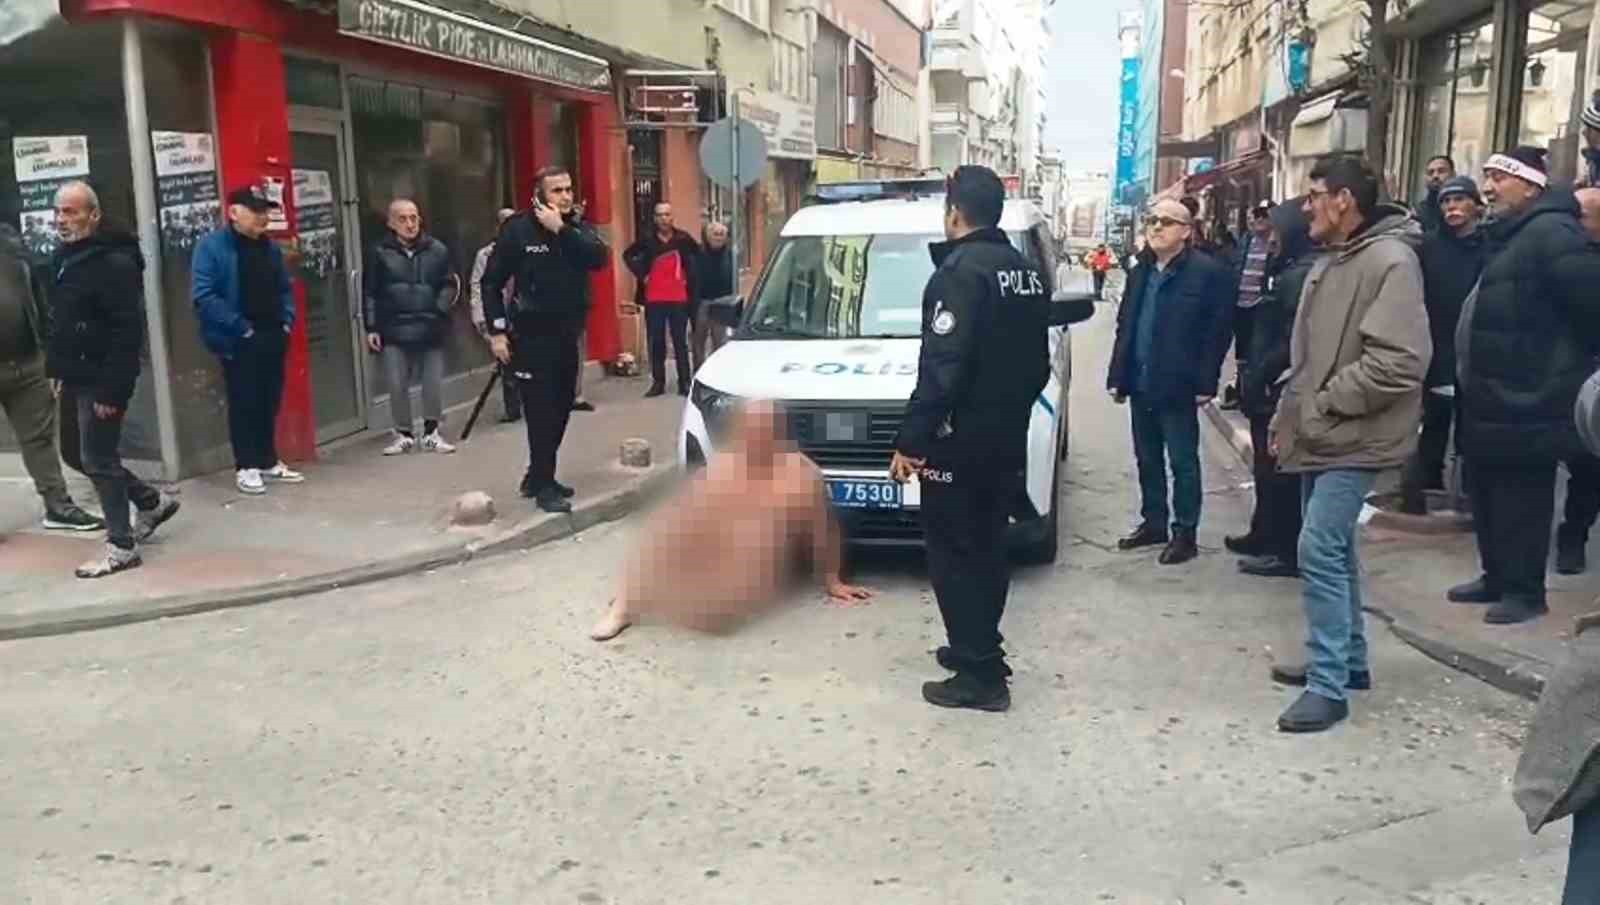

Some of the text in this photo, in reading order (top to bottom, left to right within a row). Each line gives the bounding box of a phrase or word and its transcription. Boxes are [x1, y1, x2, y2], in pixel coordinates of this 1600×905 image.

[437, 20, 475, 59] PİDE
[997, 269, 1043, 297] POLİS
[780, 360, 918, 375] POLİS
[843, 483, 894, 502] 7530
